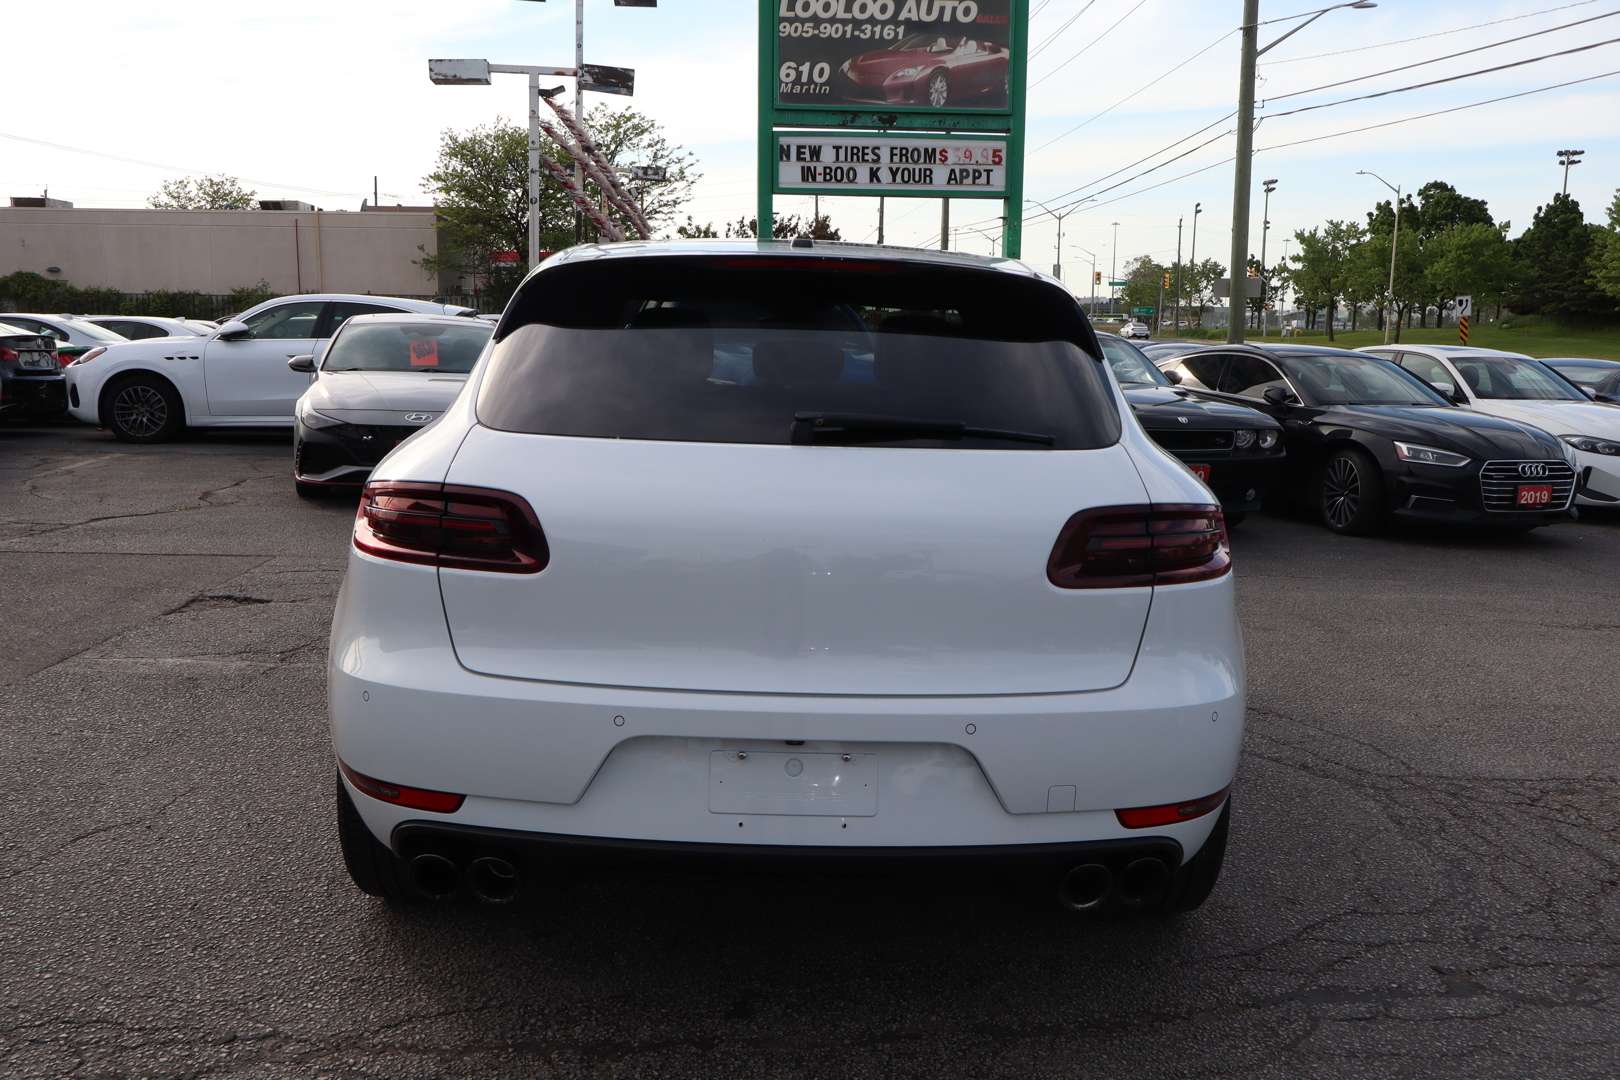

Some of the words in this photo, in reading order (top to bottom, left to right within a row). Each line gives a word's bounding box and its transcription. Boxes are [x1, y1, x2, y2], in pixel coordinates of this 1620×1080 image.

[779, 0, 895, 20] LOOLOO
[898, 0, 978, 23] AUTO
[779, 22, 905, 40] 905-901-3161
[779, 62, 830, 83] 610
[779, 84, 830, 94] Martin
[832, 146, 881, 163] TIRES
[889, 147, 936, 164] FROM
[889, 168, 933, 184] YOUR
[947, 169, 994, 185] APPT
[1520, 491, 1549, 504] 2019
